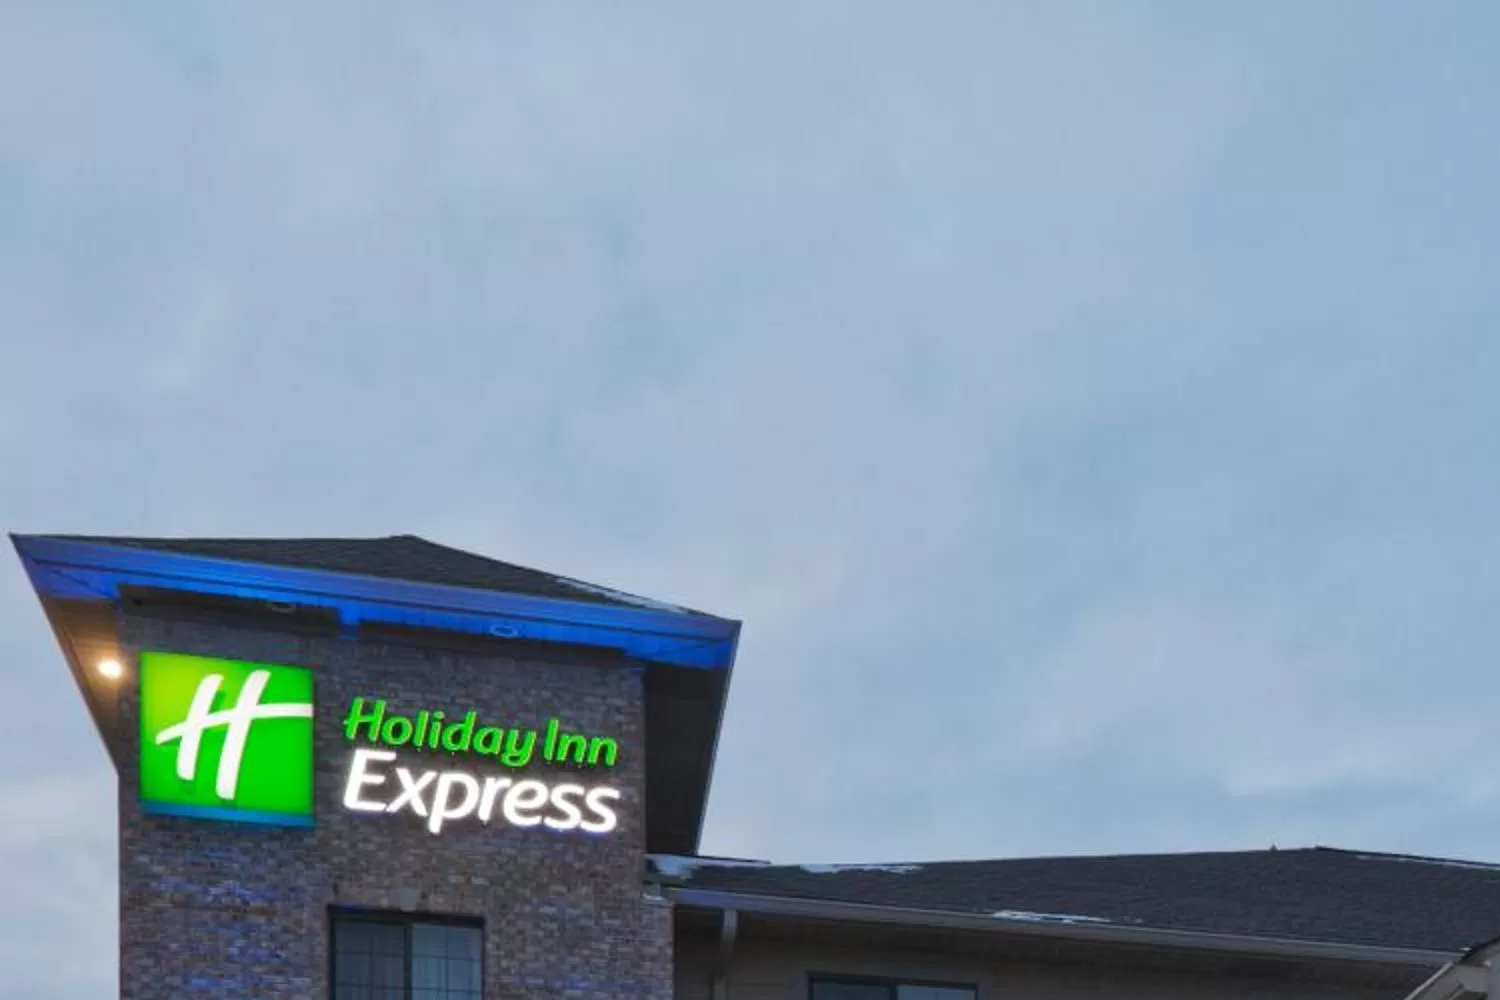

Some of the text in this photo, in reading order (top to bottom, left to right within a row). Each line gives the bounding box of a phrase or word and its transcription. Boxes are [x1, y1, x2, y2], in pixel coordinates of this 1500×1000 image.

[344, 697, 618, 768] Holiday Inn
[343, 749, 620, 834] Express
